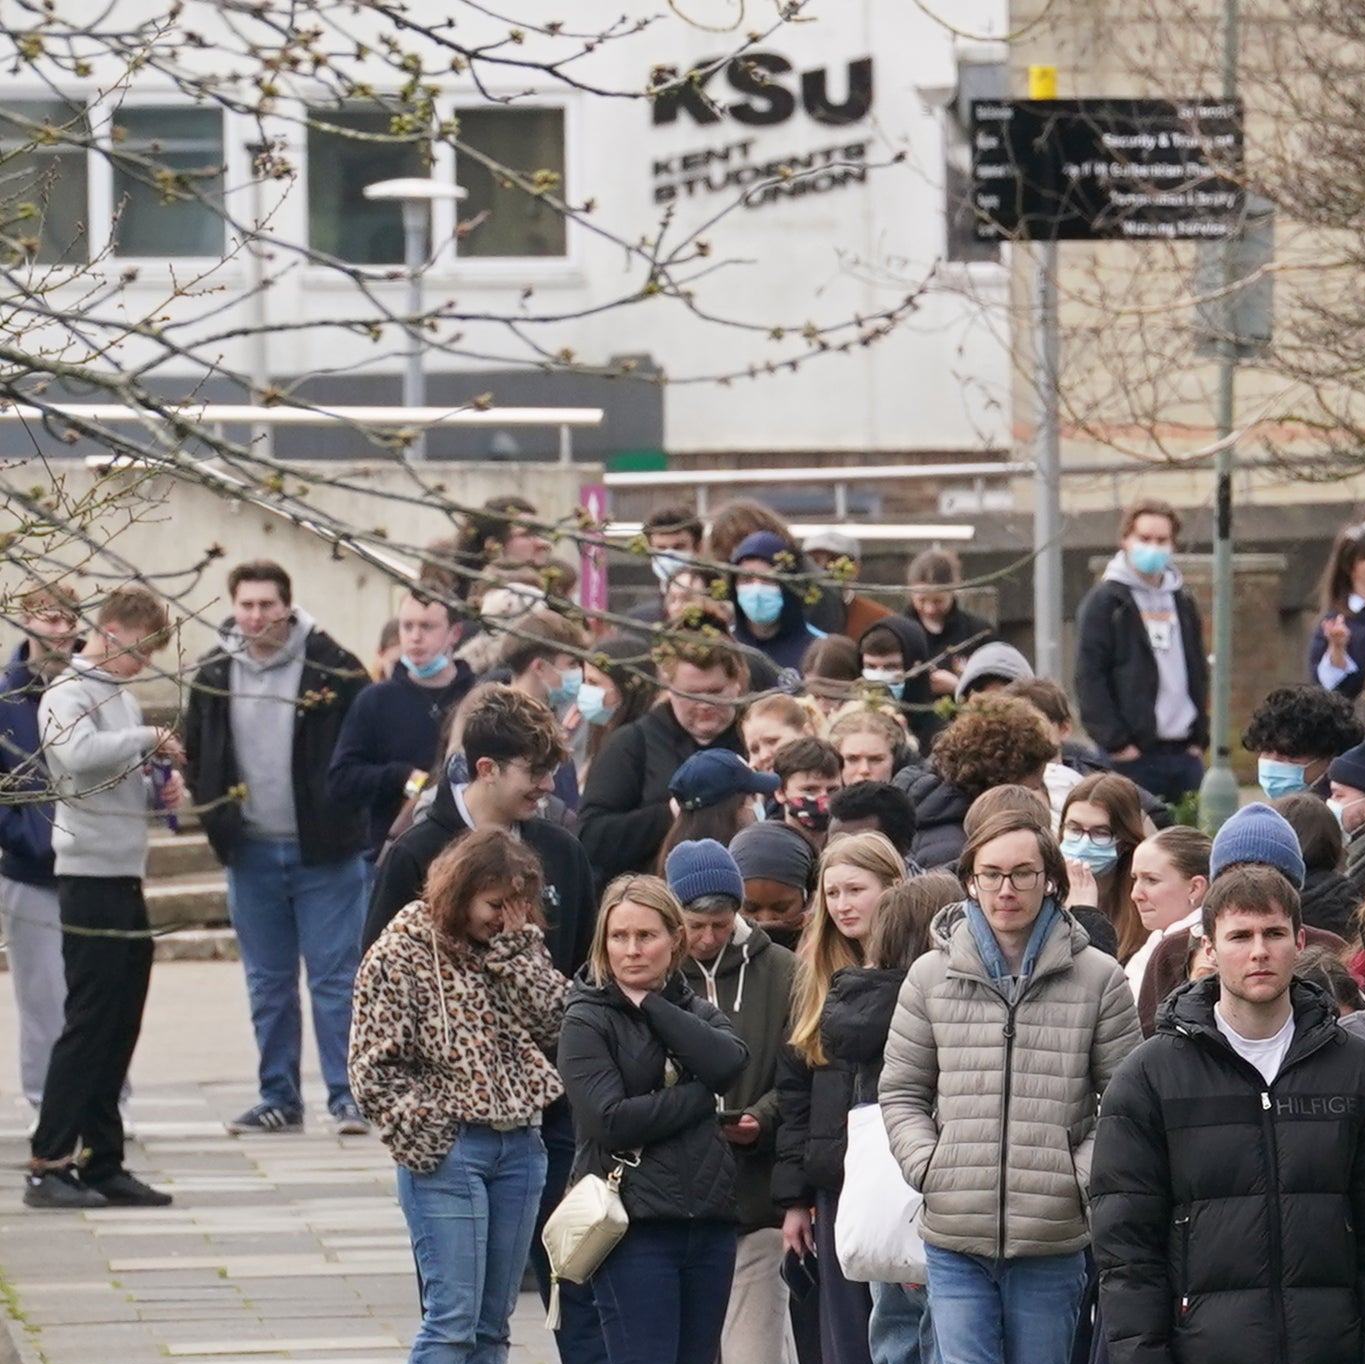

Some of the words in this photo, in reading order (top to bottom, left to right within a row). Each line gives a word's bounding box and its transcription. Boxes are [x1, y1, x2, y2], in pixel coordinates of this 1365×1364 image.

[651, 52, 873, 125] KSU
[653, 139, 754, 177] KENT
[744, 166, 867, 209] UNION
